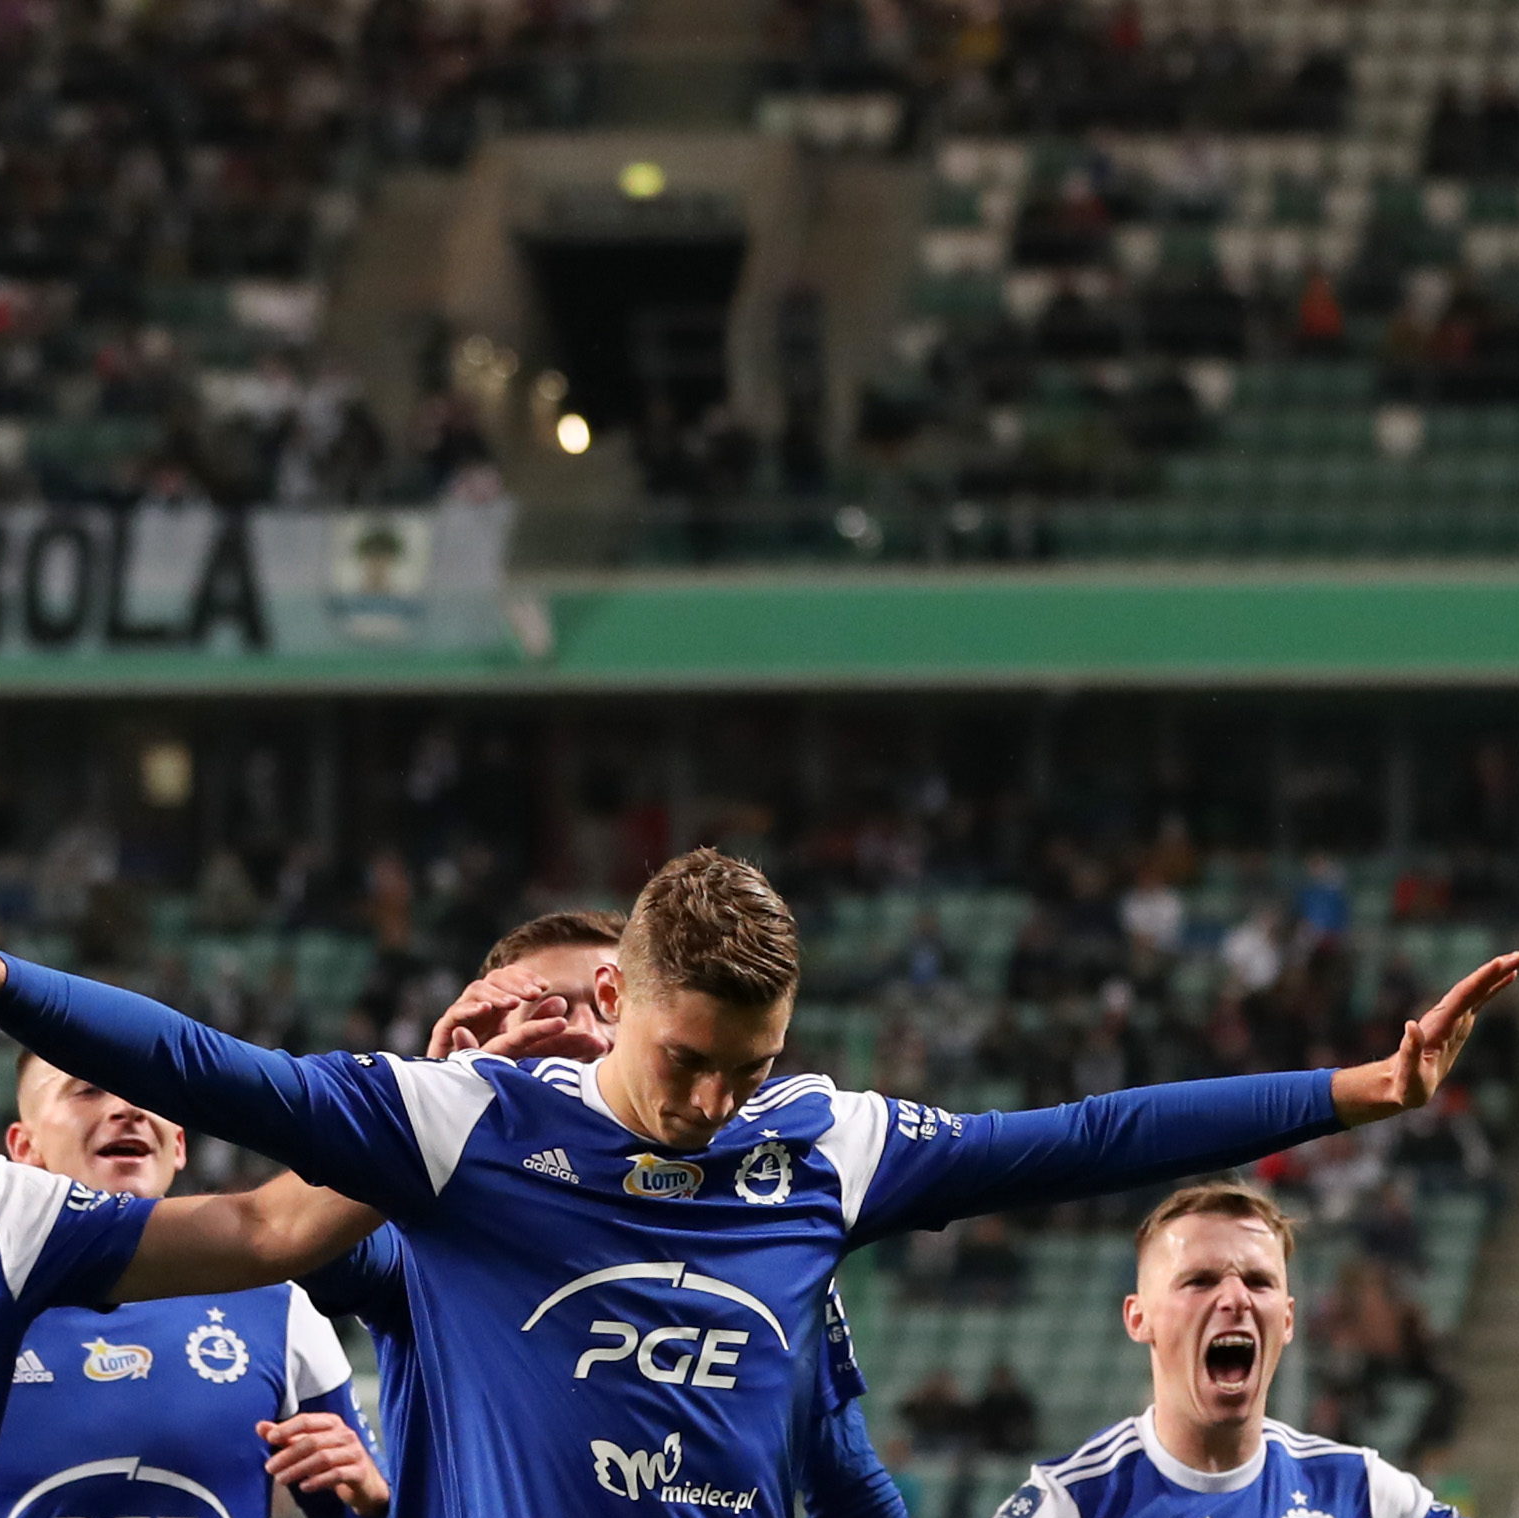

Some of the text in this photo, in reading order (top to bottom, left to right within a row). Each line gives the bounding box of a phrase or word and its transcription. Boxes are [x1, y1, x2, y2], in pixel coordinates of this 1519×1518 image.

[523, 1158, 580, 1184] adidas
[642, 1171, 687, 1190] LOTTO
[98, 1354, 137, 1372] LOTTO
[573, 1320, 750, 1390] PGE
[660, 1482, 758, 1514] mielec.pl
